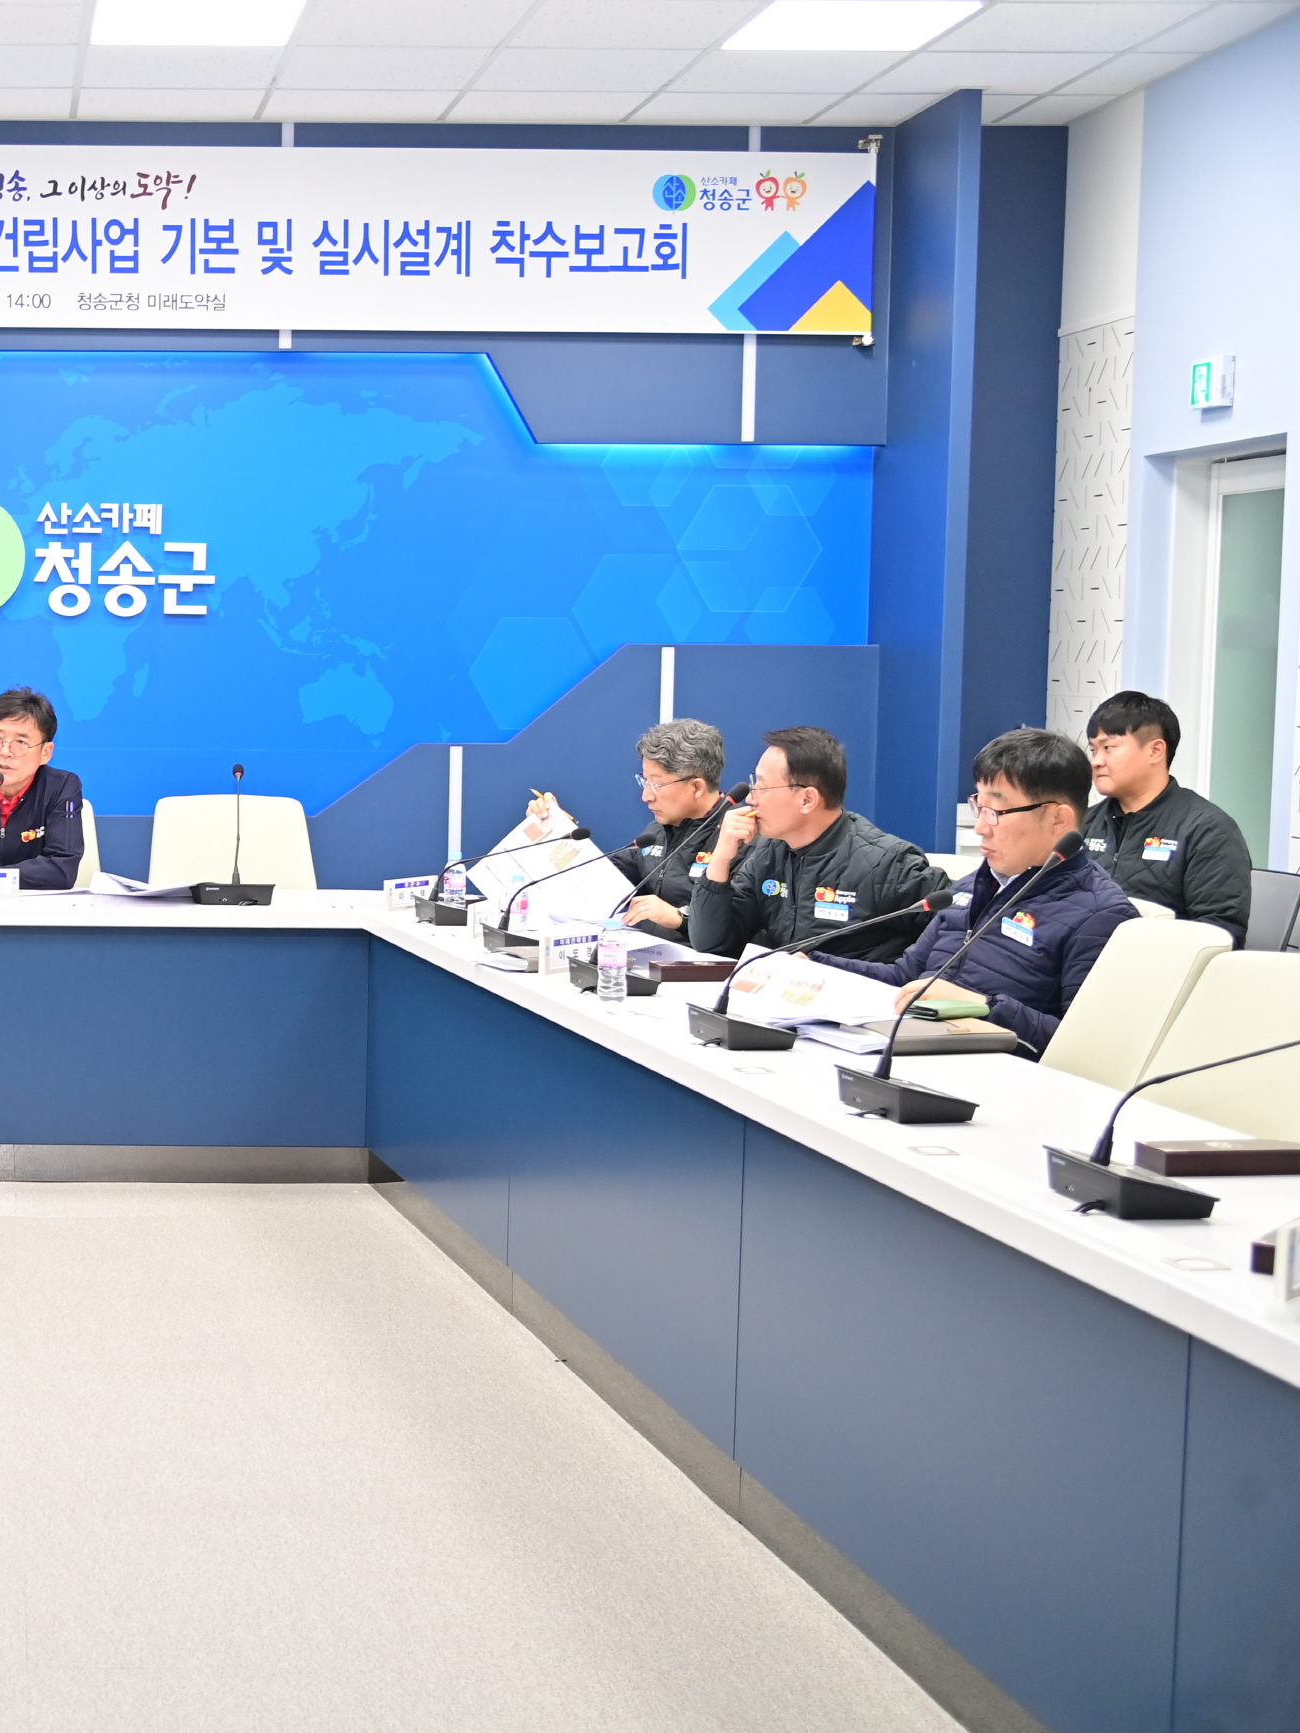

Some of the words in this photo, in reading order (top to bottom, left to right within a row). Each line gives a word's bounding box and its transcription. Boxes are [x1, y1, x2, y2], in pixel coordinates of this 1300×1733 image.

[40, 179, 63, 198] 그
[67, 175, 127, 202] 이상의
[130, 170, 197, 210] 도약!
[700, 176, 738, 187] 산소카페
[698, 188, 753, 211] 청송군
[160, 218, 239, 275] 기본
[257, 218, 294, 276] 및
[311, 219, 472, 278] 실시설계
[489, 219, 688, 279] 착수보고회
[7, 293, 52, 309] 14:00
[77, 292, 140, 311] 청송군청
[147, 293, 226, 312] 미래도약실
[37, 501, 163, 535] 산소카페
[33, 540, 216, 617] 청송군
[834, 893, 856, 904] Apple
